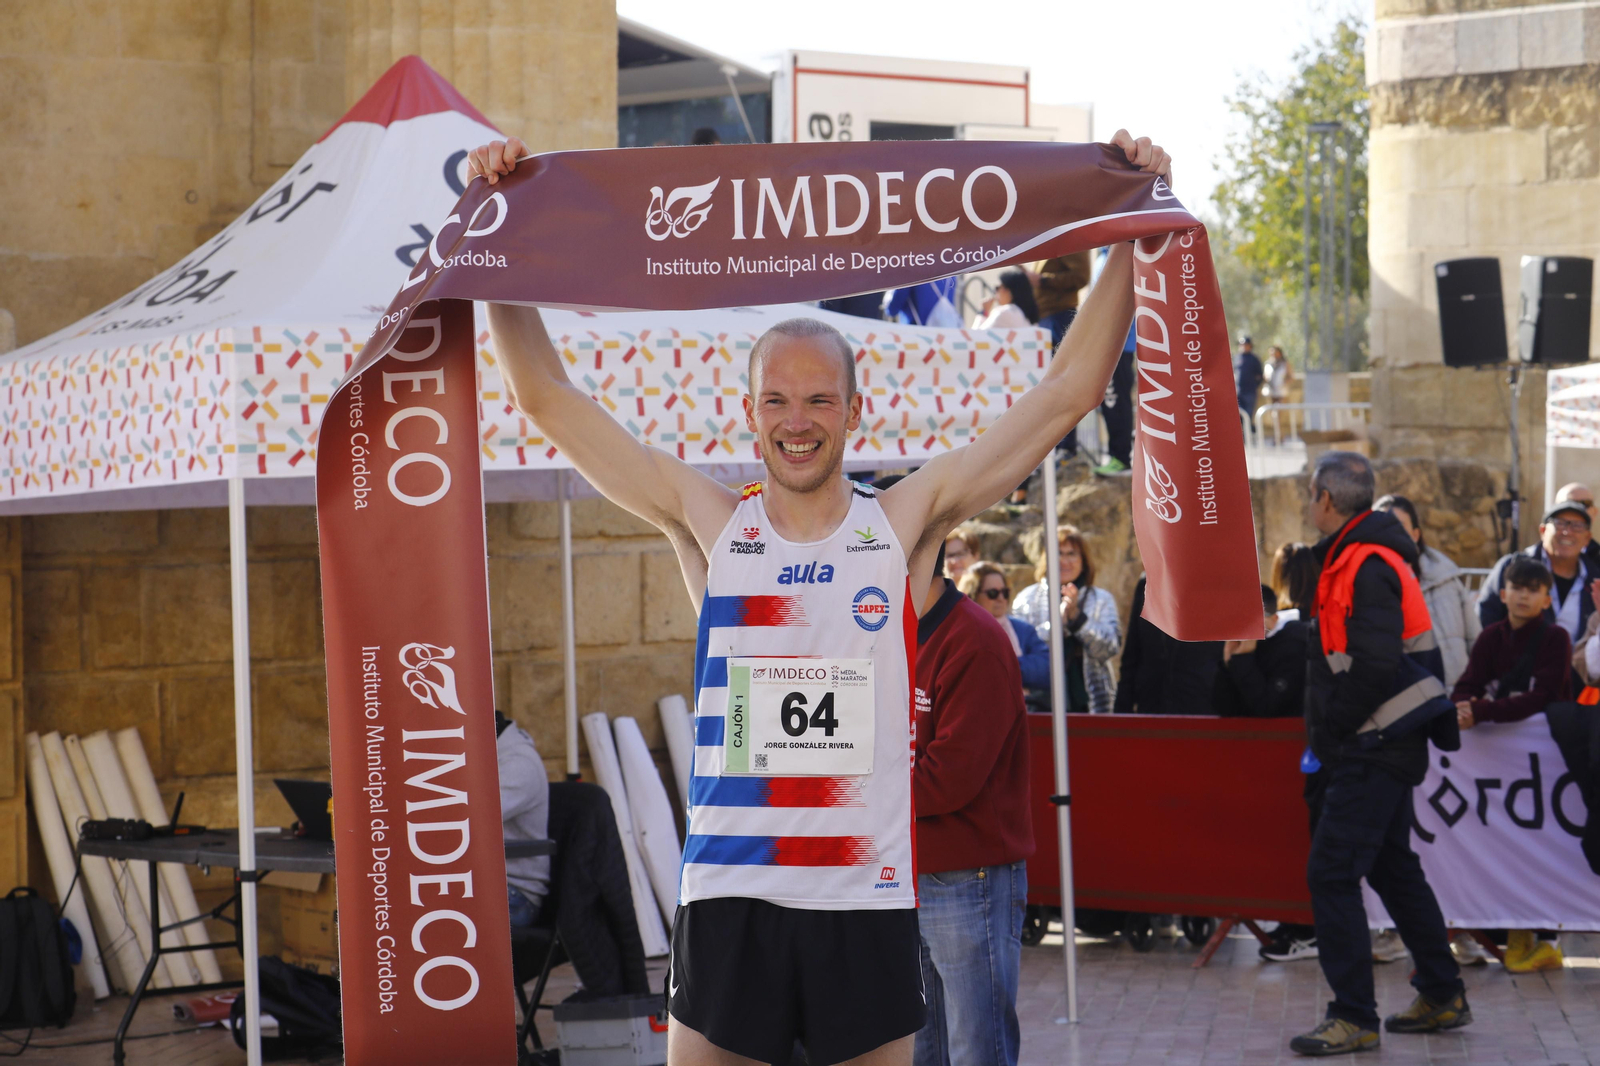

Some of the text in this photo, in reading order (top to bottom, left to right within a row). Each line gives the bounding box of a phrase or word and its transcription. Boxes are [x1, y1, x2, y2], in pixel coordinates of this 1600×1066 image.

[730, 165, 1018, 240] IMDECO
[646, 257, 721, 276] Instituto
[727, 252, 817, 277] Municipal
[822, 253, 846, 271] de
[850, 248, 936, 273] Deportes
[1179, 253, 1204, 335] Deportes
[1184, 340, 1201, 363] de
[1185, 368, 1210, 451] Municipal
[350, 432, 372, 511] Córdoba
[1198, 457, 1218, 525] Instituto
[846, 543, 891, 553] Extremadura
[777, 561, 835, 585] aula
[858, 604, 885, 614] CAPEX
[769, 667, 826, 680] IMDECO
[840, 673, 868, 681] MARATÓN
[732, 704, 744, 748] CAJÓN
[781, 691, 839, 737] 64
[789, 741, 827, 749] GONZÁLEZ
[362, 645, 398, 1015] Instituto Municipal de Deportes Córdoba
[402, 726, 480, 1011] IMDECO
[882, 868, 895, 879] IN
